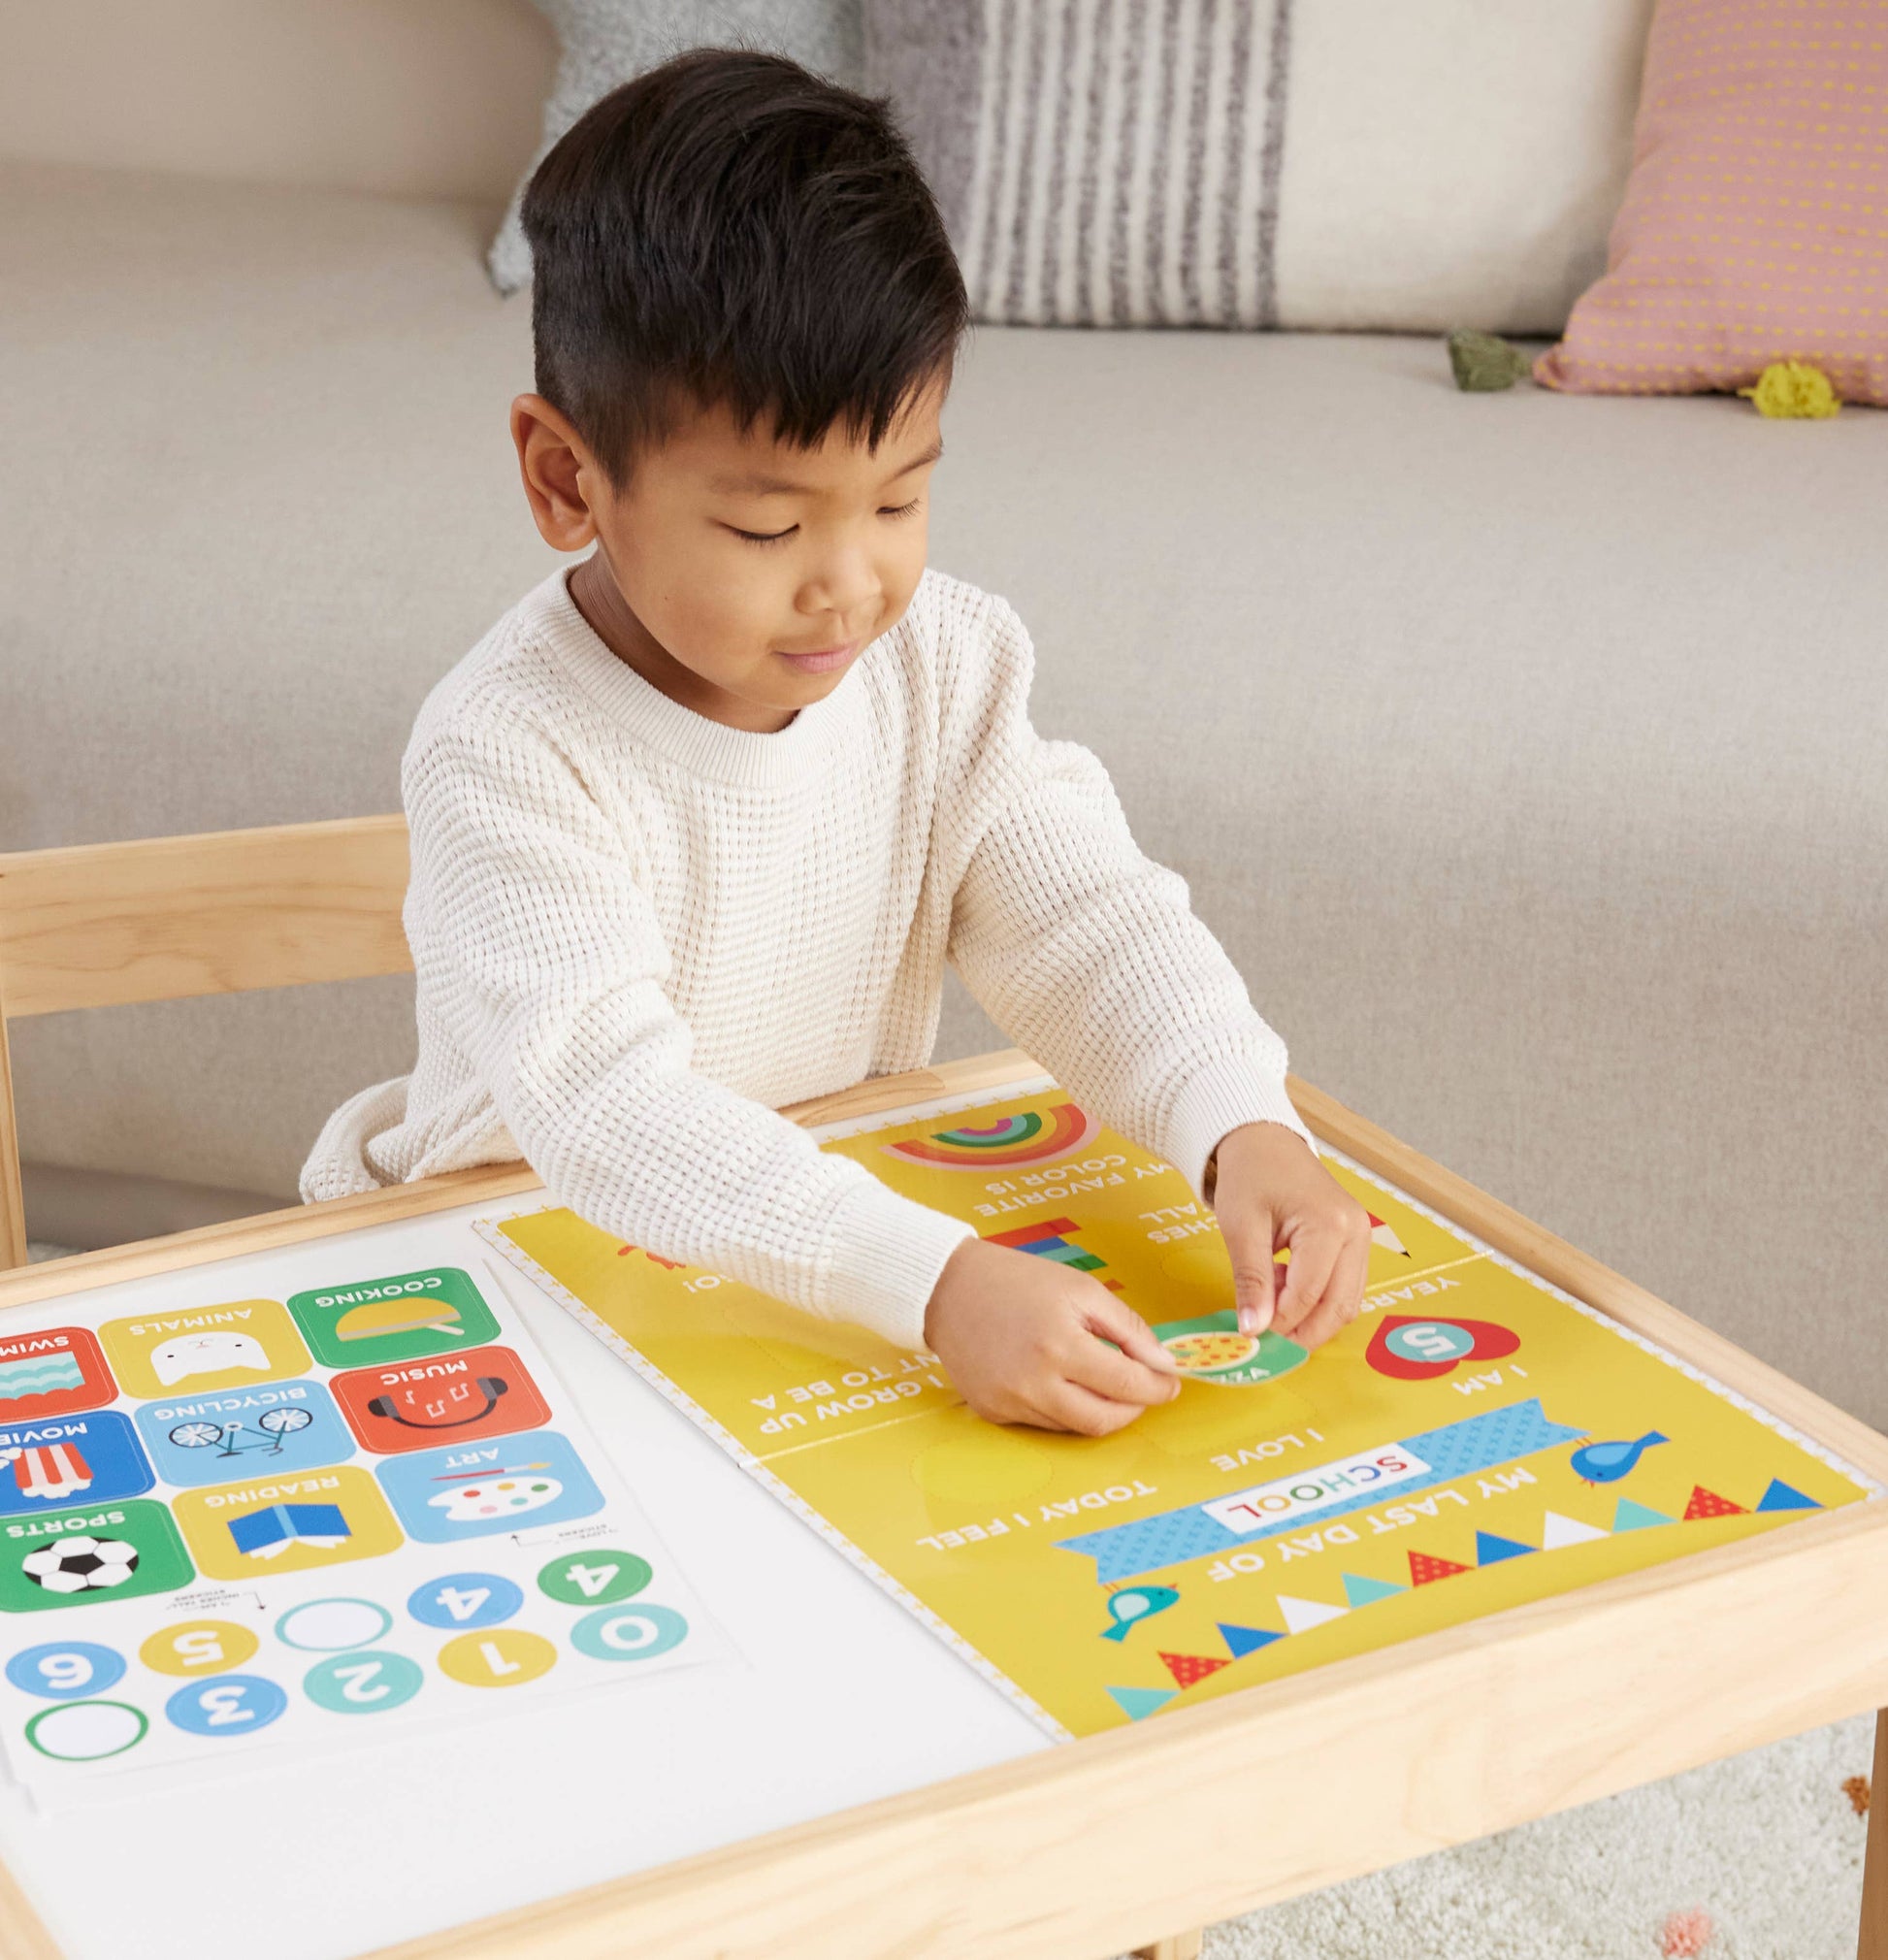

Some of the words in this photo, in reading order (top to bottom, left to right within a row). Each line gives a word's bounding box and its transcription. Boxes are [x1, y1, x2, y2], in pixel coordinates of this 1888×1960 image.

[1020, 1154, 1126, 1188] COLOR
[973, 1168, 1125, 1217] FAVORITE
[985, 1181, 1018, 1196] IS
[1138, 1201, 1213, 1225] ALL
[314, 1276, 442, 1308] COOKING
[1359, 1276, 1461, 1313] YEARS
[129, 1308, 253, 1336] ANIMALS
[1402, 1326, 1457, 1357] 5
[382, 1359, 468, 1386] MUSIC
[841, 1364, 892, 1388] TO
[928, 1374, 945, 1388] I
[1451, 1369, 1504, 1395] AM
[1510, 1363, 1529, 1378] I
[154, 1387, 308, 1421] BICYCLING
[750, 1394, 776, 1411] A
[786, 1380, 835, 1404] BE
[815, 1381, 921, 1421] GROW
[760, 1412, 807, 1435] UP
[1306, 1427, 1325, 1443] I
[445, 1447, 499, 1469] ART
[1210, 1434, 1305, 1472] LOVE
[205, 1475, 340, 1509] READING
[1226, 1455, 1408, 1519] SCHOOL
[1476, 1467, 1538, 1499] MY
[1039, 1480, 1158, 1522] TODAY
[1366, 1488, 1469, 1535] LAST
[6, 1511, 126, 1538] SPORTS
[915, 1518, 1010, 1552] FEEL
[1013, 1513, 1031, 1528] I
[1277, 1523, 1359, 1562] DAY
[565, 1562, 621, 1597] 4
[1207, 1553, 1265, 1583] OF
[436, 1586, 491, 1621] 4
[172, 1630, 225, 1667] 5
[478, 1641, 522, 1676] 1
[38, 1653, 94, 1689] 6
[334, 1661, 392, 1704] 2
[198, 1687, 254, 1727] 3
